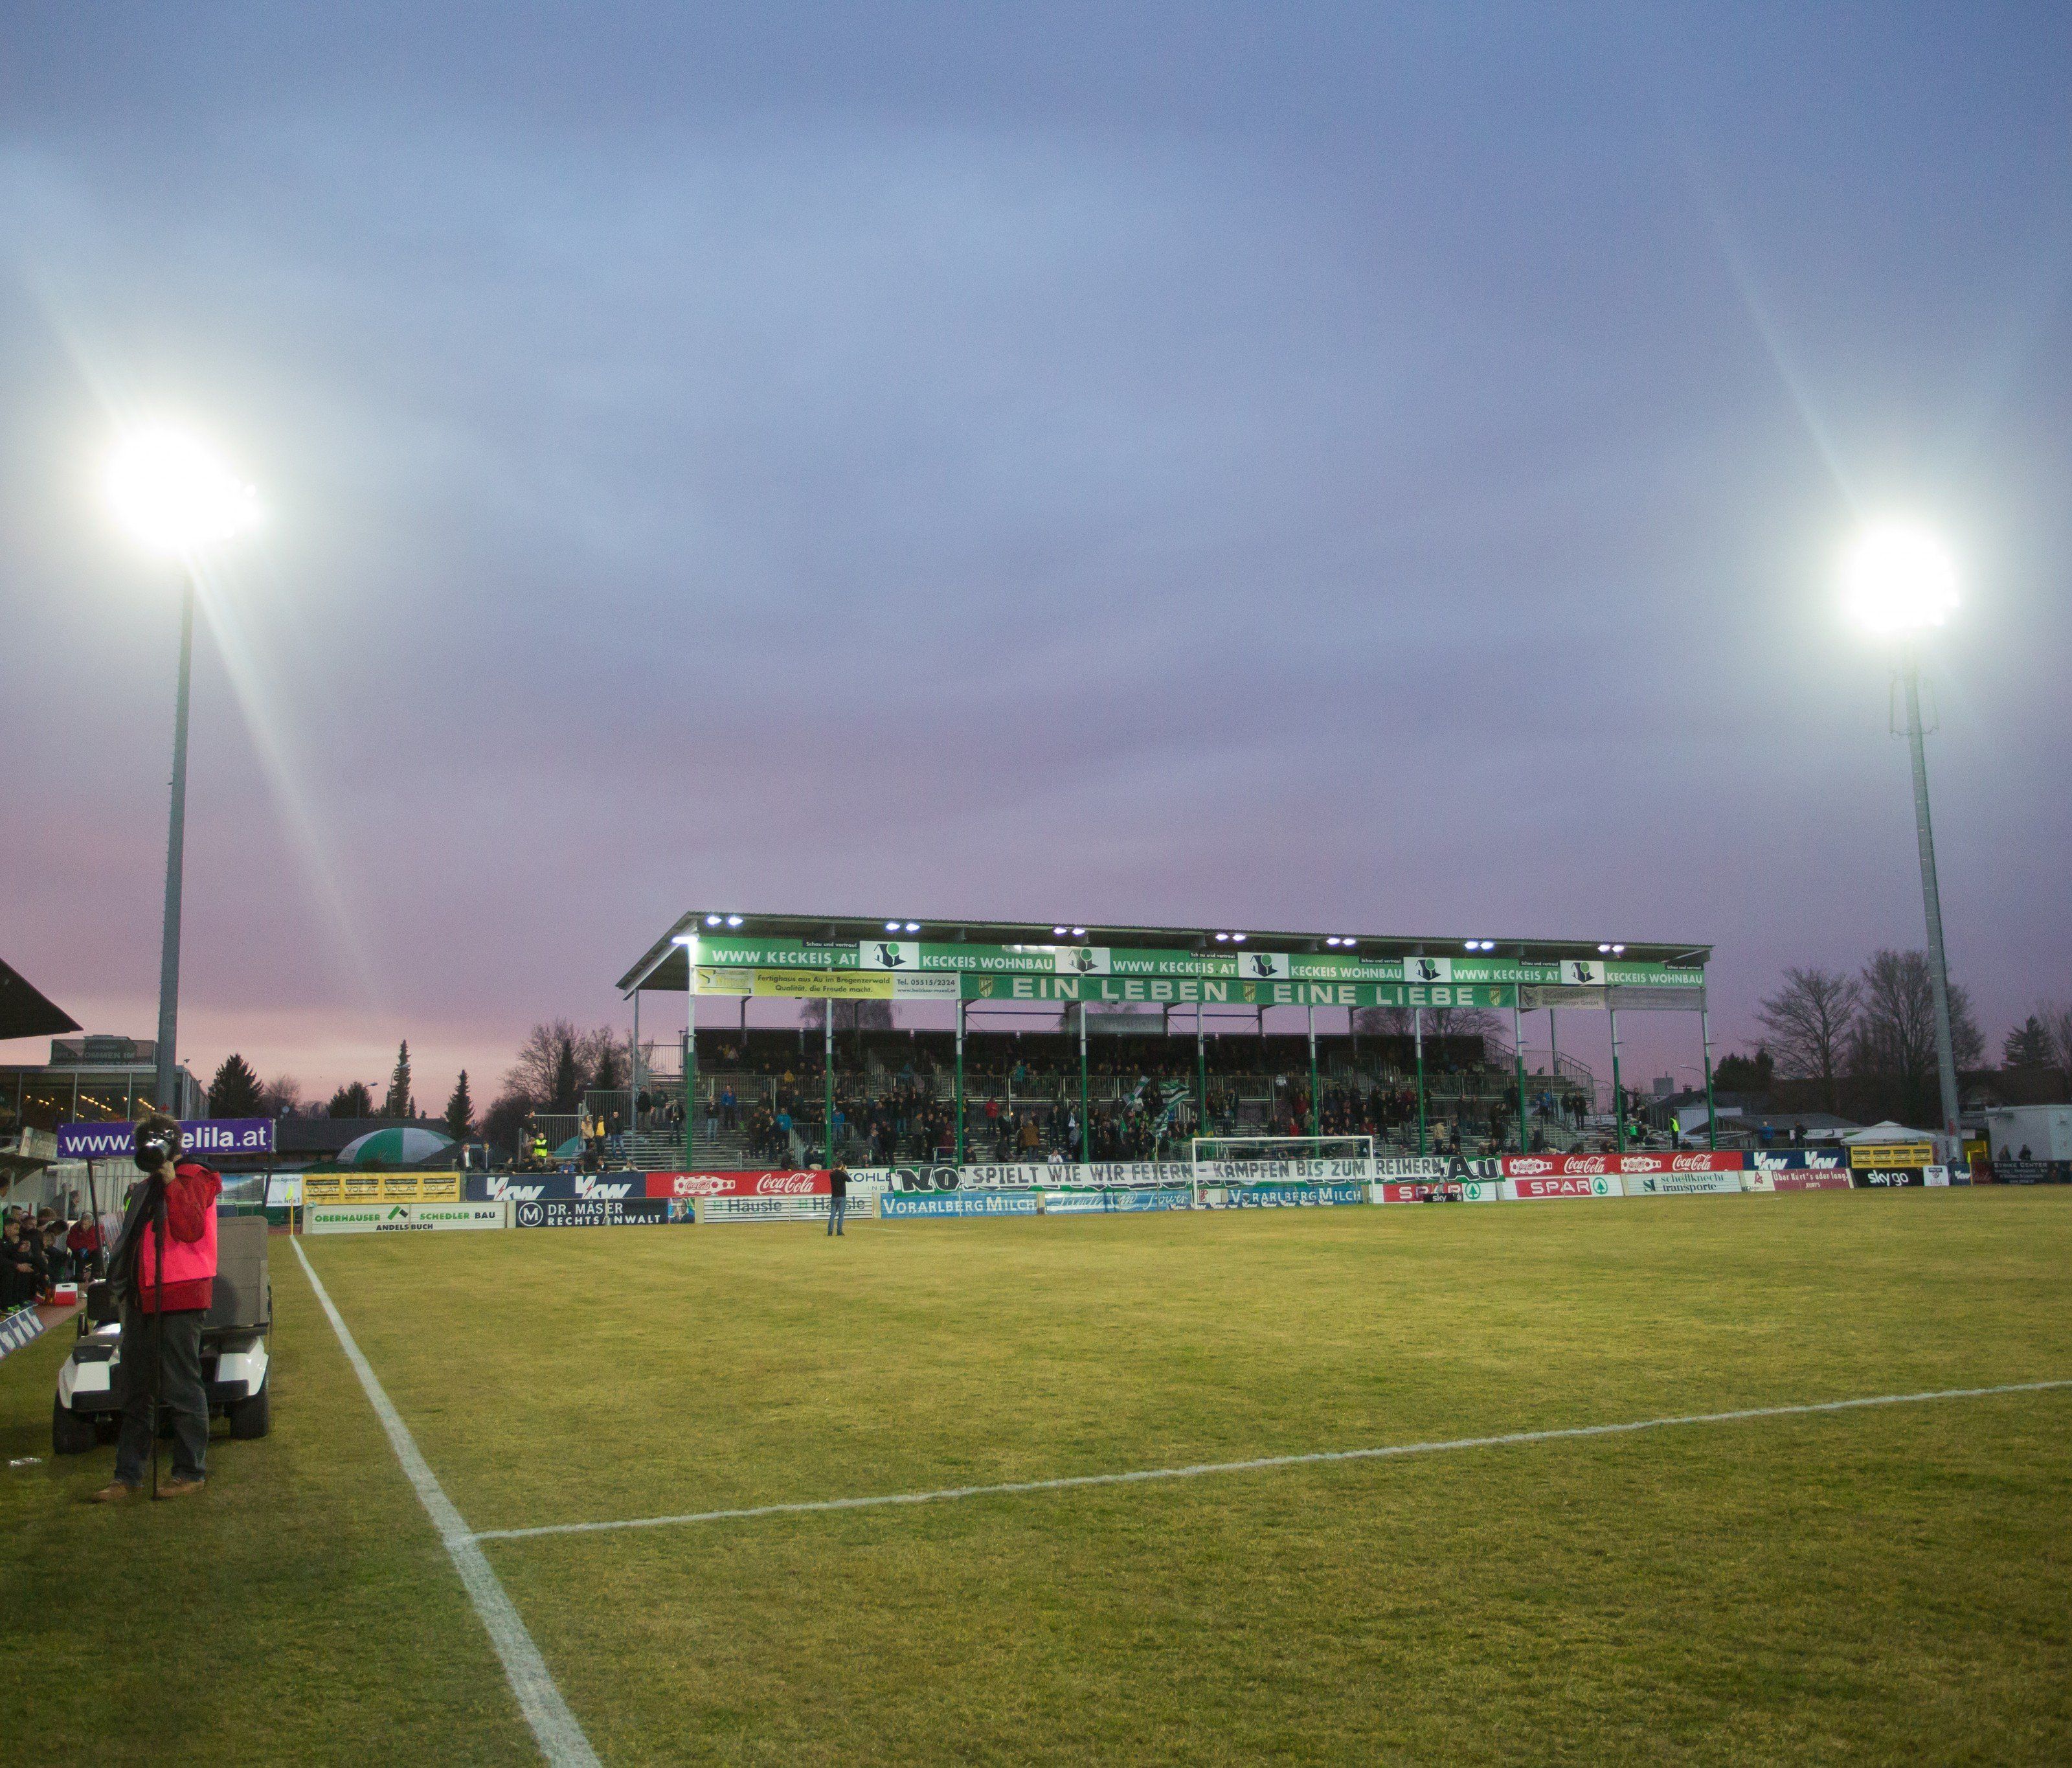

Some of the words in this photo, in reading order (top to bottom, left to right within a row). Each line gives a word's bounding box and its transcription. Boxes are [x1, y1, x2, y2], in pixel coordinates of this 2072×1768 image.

[923, 955, 976, 968] KECKEIS
[980, 957, 1053, 970] WOHNBAU
[758, 975, 796, 983] Fertighaus
[837, 976, 890, 985] Bregenzerwald
[1291, 966, 1336, 977] KECKEIS
[1340, 967, 1402, 979] WOHNBAU
[1606, 972, 1646, 983] KECKEIS
[1649, 973, 1702, 984] WOHNBAU
[1013, 977, 1079, 999] EIN
[1101, 979, 1227, 1001] LEBEN
[1274, 984, 1357, 1004] EINE
[1376, 986, 1474, 1005] LIEBE
[1564, 1156, 1606, 1174] Coca-Cola
[1672, 1154, 1713, 1171] Coca-Cola
[973, 1166, 1039, 1184] SPIELT
[1047, 1164, 1081, 1183] WIE
[1090, 1164, 1125, 1181] WIR
[1131, 1163, 1193, 1181] FEIERN
[1296, 1160, 1323, 1177] BIS
[1331, 1159, 1365, 1177] ZUM
[1773, 1171, 1789, 1181] Über
[1815, 1171, 1829, 1179] oder
[1867, 1170, 1890, 1186] sky
[1891, 1173, 1909, 1186] go
[756, 1173, 818, 1194] Coca-Cola
[1531, 1180, 1590, 1195] SPAR
[1663, 1183, 1717, 1194] transporte
[1230, 1189, 1316, 1202] VRARLBERG
[1318, 1188, 1361, 1201] MILCH
[1432, 1194, 1447, 1203] sky
[548, 1204, 571, 1216] DR.
[575, 1201, 623, 1215] MÄSER
[728, 1197, 782, 1212] Häusle
[813, 1196, 865, 1211] Häsle
[883, 1198, 984, 1214] VORARLBERG
[986, 1196, 1037, 1212] MILCH
[314, 1214, 381, 1222] OBERHAUSER
